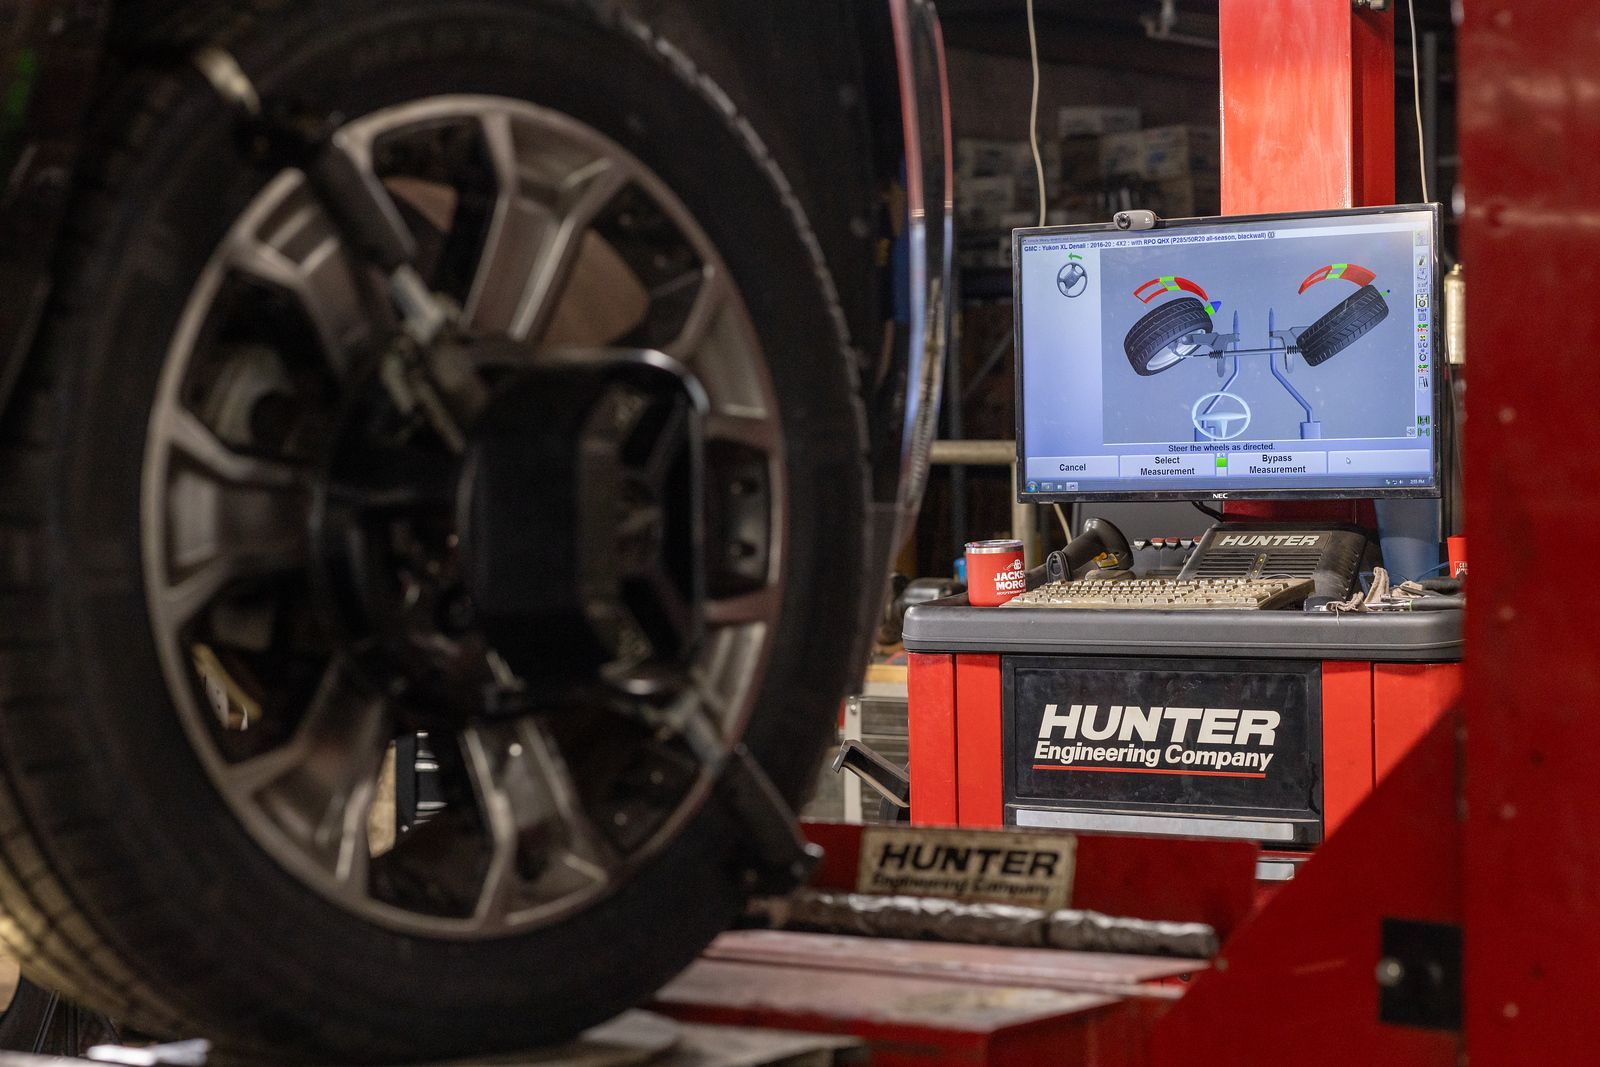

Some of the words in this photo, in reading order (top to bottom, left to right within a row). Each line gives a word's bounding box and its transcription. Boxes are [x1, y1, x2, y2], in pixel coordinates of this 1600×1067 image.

[1237, 232, 1267, 240] blackwall)
[1168, 444, 1188, 453] Steer
[1190, 444, 1202, 452] the
[1203, 443, 1230, 452] wheels
[1243, 443, 1276, 451] directed.
[1155, 456, 1180, 464] Select
[1262, 454, 1292, 463] Bypass
[1059, 463, 1086, 472] Cancel
[1140, 467, 1195, 476] Measurement
[1249, 465, 1306, 474] Measurement
[1219, 535, 1320, 546] HUNTER
[994, 570, 1026, 582] JACKS
[1037, 703, 1281, 746] HUNTER
[1033, 740, 1161, 768] Engineering
[1164, 744, 1274, 772] Company
[878, 842, 1060, 878] HUNTER
